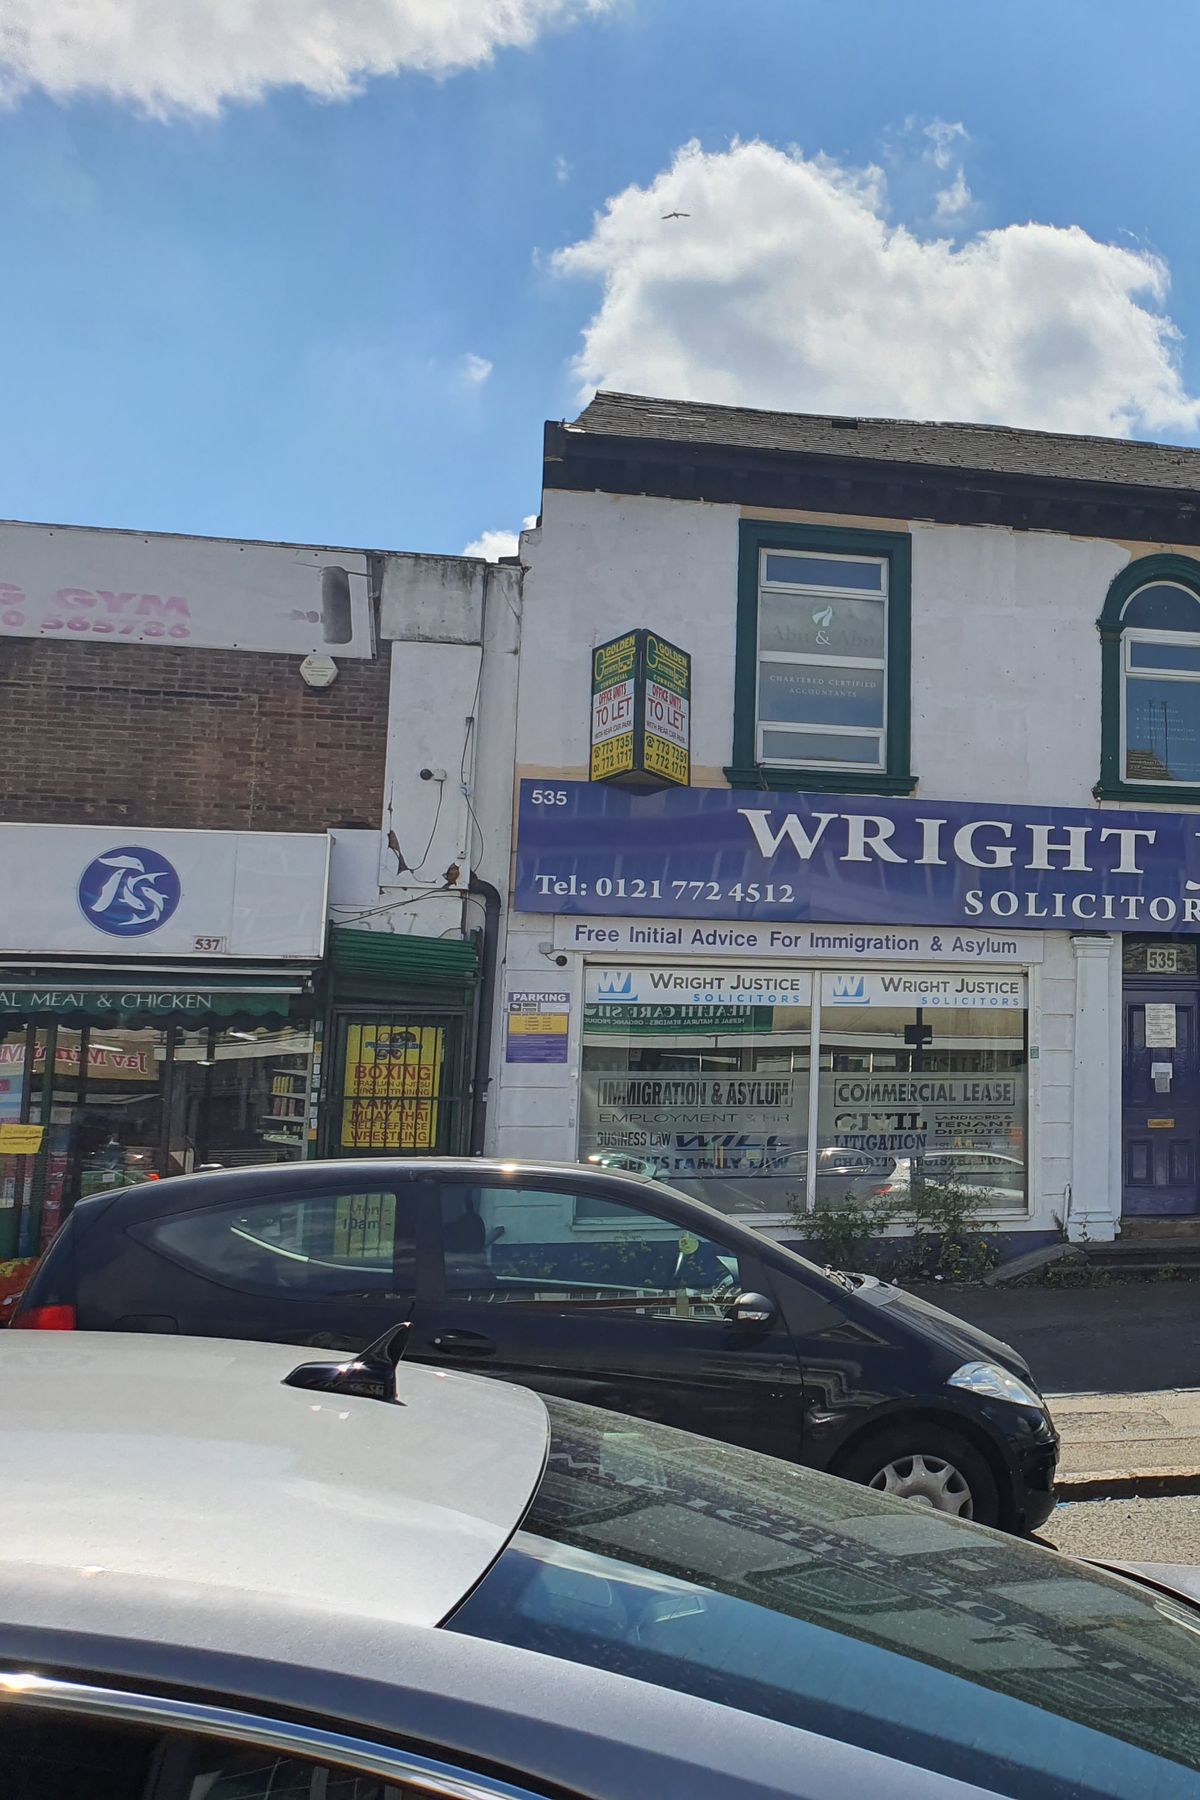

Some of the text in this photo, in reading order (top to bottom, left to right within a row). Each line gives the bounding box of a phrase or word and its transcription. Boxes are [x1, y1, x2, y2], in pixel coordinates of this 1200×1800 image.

[56, 587, 191, 618] GYM
[605, 635, 635, 657] GOLDEN
[815, 630, 831, 645] &
[659, 643, 688, 667] GOLDEN
[596, 697, 632, 727] TO LET
[648, 697, 685, 731] TO LET
[601, 741, 613, 755] 773
[656, 739, 687, 764] 773 7351
[602, 755, 614, 769] 772
[655, 753, 669, 769] 772
[671, 761, 687, 777] 1717
[531, 789, 568, 806] 535
[737, 808, 1157, 874] WRIGHT
[535, 874, 795, 903] Tel: 0121 772 4512
[195, 938, 220, 951] 537
[575, 924, 1017, 956] Free Initial Advice For Immigration & Asylum
[1149, 951, 1176, 968] 535
[650, 973, 800, 991] WRIGHT JUSTICE
[881, 976, 1019, 994] WRIGHT JUSTICE
[30, 992, 88, 1006] MEAT
[97, 992, 112, 1008] &
[120, 993, 212, 1009] CHICKEN
[513, 993, 567, 1002] PARKING
[694, 993, 800, 1003] SOLICITORS
[921, 996, 1019, 1006] SOLICITORS
[354, 1065, 431, 1081] BOXING
[602, 1080, 789, 1106] IMMIGRATION & ASYLUM
[838, 1082, 1012, 1103] COMMERCIAL LEASE
[351, 1110, 429, 1122] MUAY THAI
[599, 1113, 739, 1123] EMPLOYMENT
[834, 1112, 928, 1132] CIVIL
[351, 1121, 428, 1131] SELF DEFENCE
[350, 1131, 427, 1142] WRESTLING
[597, 1131, 672, 1147] BUSINESS LAW
[834, 1133, 928, 1151] LITIGATION
